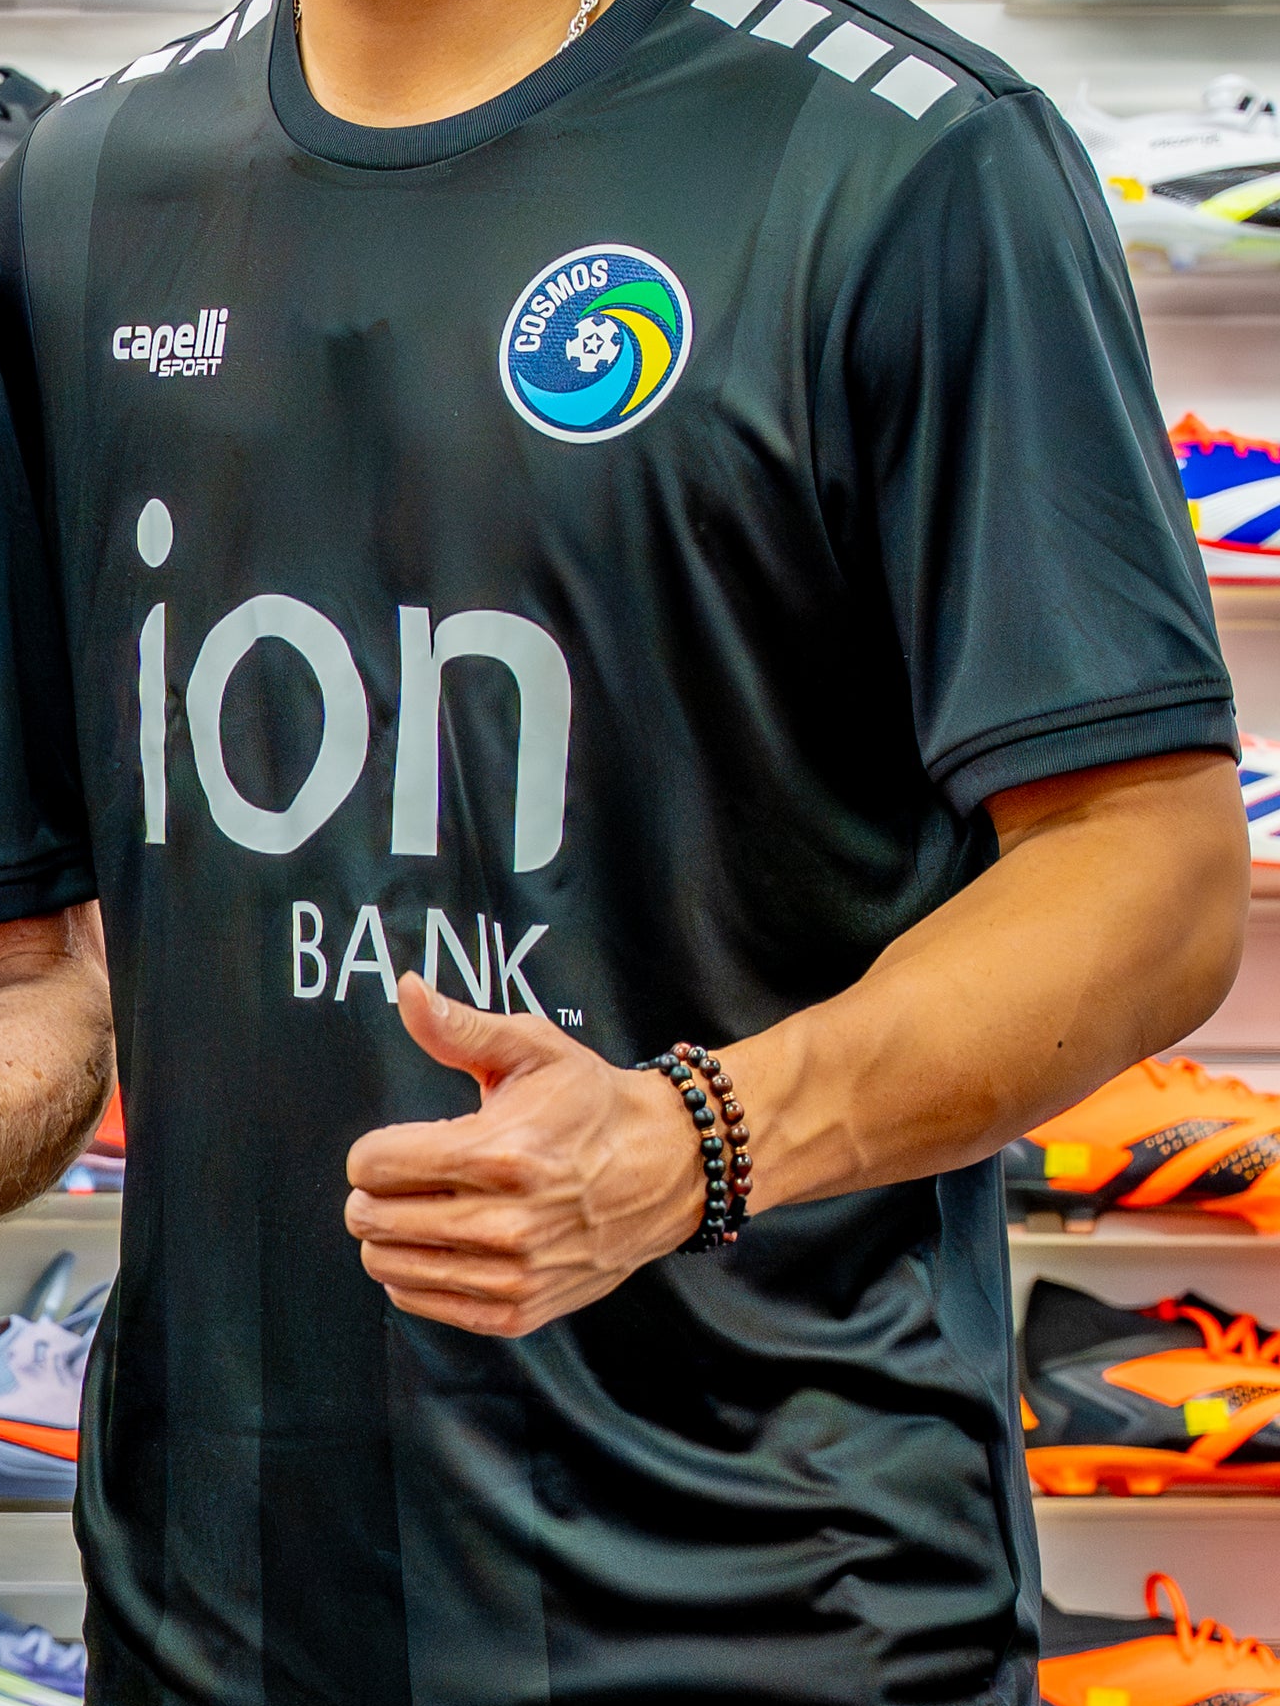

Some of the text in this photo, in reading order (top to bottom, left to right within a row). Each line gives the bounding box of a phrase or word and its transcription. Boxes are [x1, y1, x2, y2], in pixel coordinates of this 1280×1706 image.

[113, 308, 229, 373] capelli
[515, 258, 608, 353] COSMOS
[158, 358, 222, 377] SPORT
[137, 497, 572, 873] ion
[293, 899, 550, 1019] BANK
